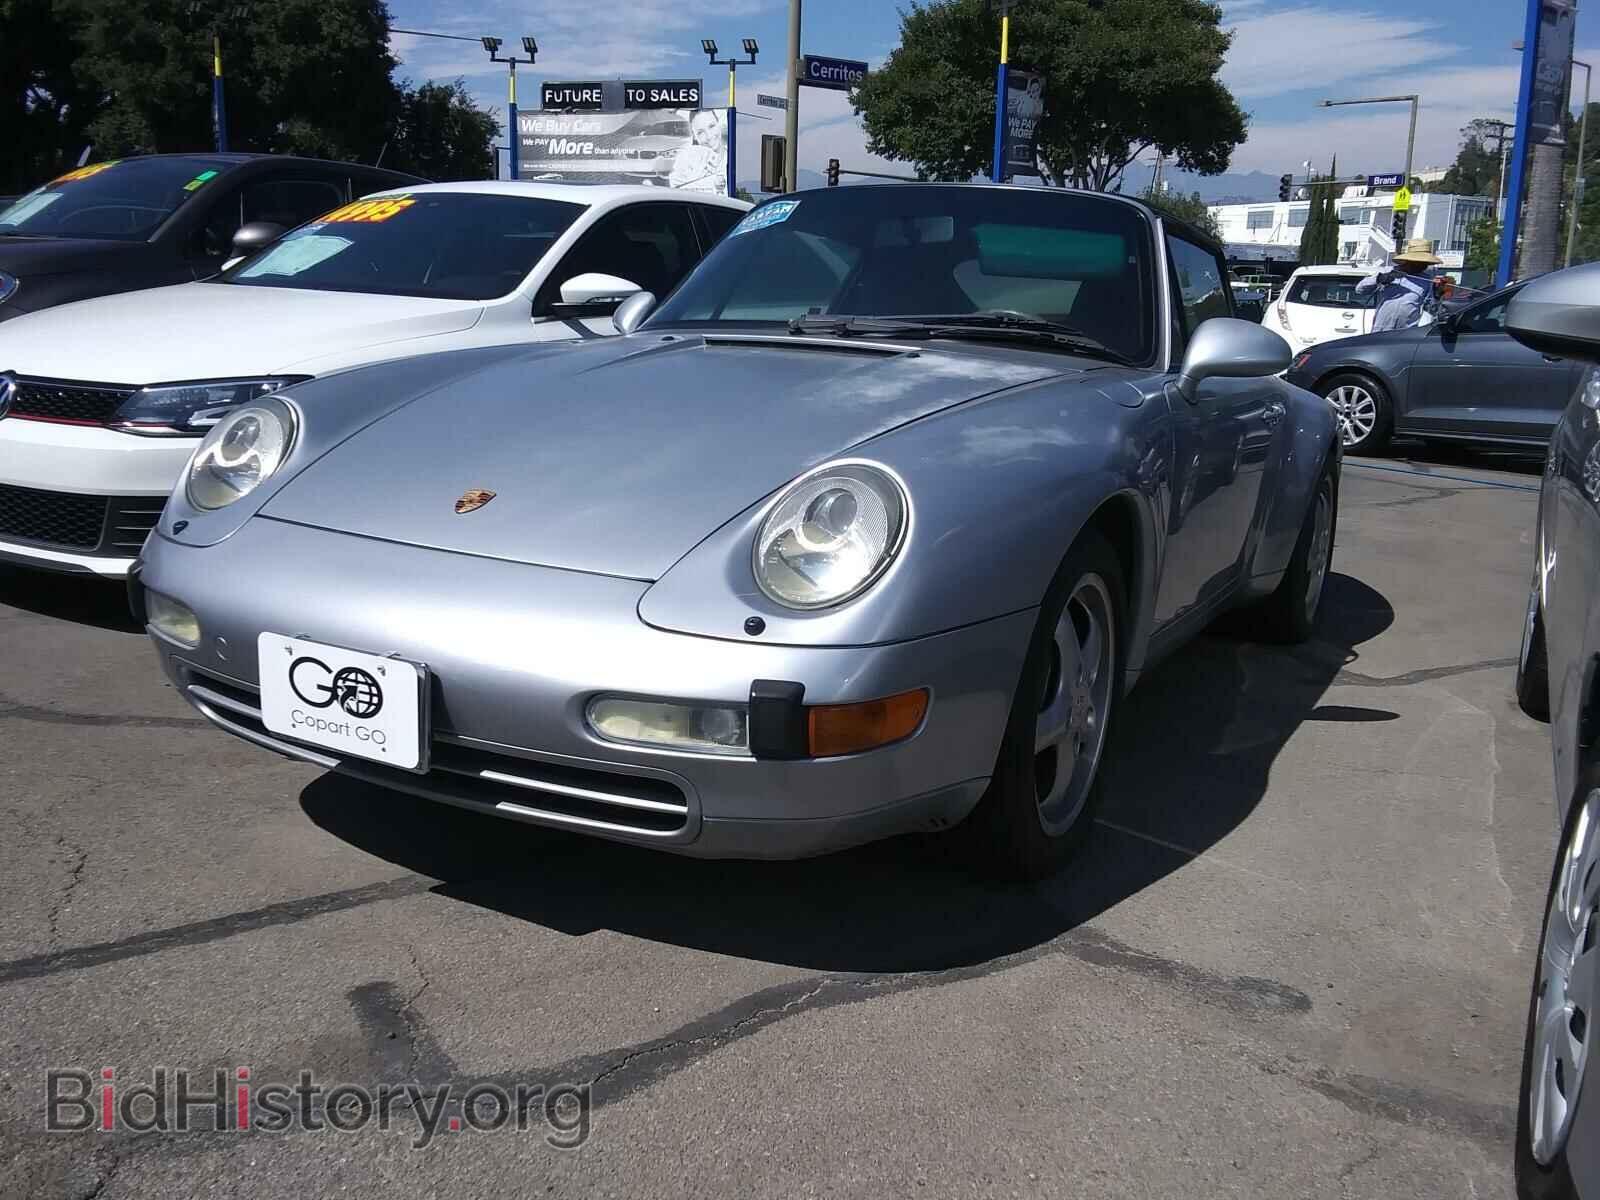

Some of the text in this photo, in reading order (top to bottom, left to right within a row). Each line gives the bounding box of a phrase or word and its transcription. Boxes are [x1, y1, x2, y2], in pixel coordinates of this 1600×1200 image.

[811, 61, 863, 81] Cerritos
[544, 88, 699, 103] FUTURE TO SALES
[521, 119, 544, 132] We
[545, 119, 572, 134] Buy
[1022, 119, 1038, 131] PAY
[548, 138, 594, 155] More
[1373, 176, 1397, 185] Brand
[290, 709, 387, 745] Copart GO
